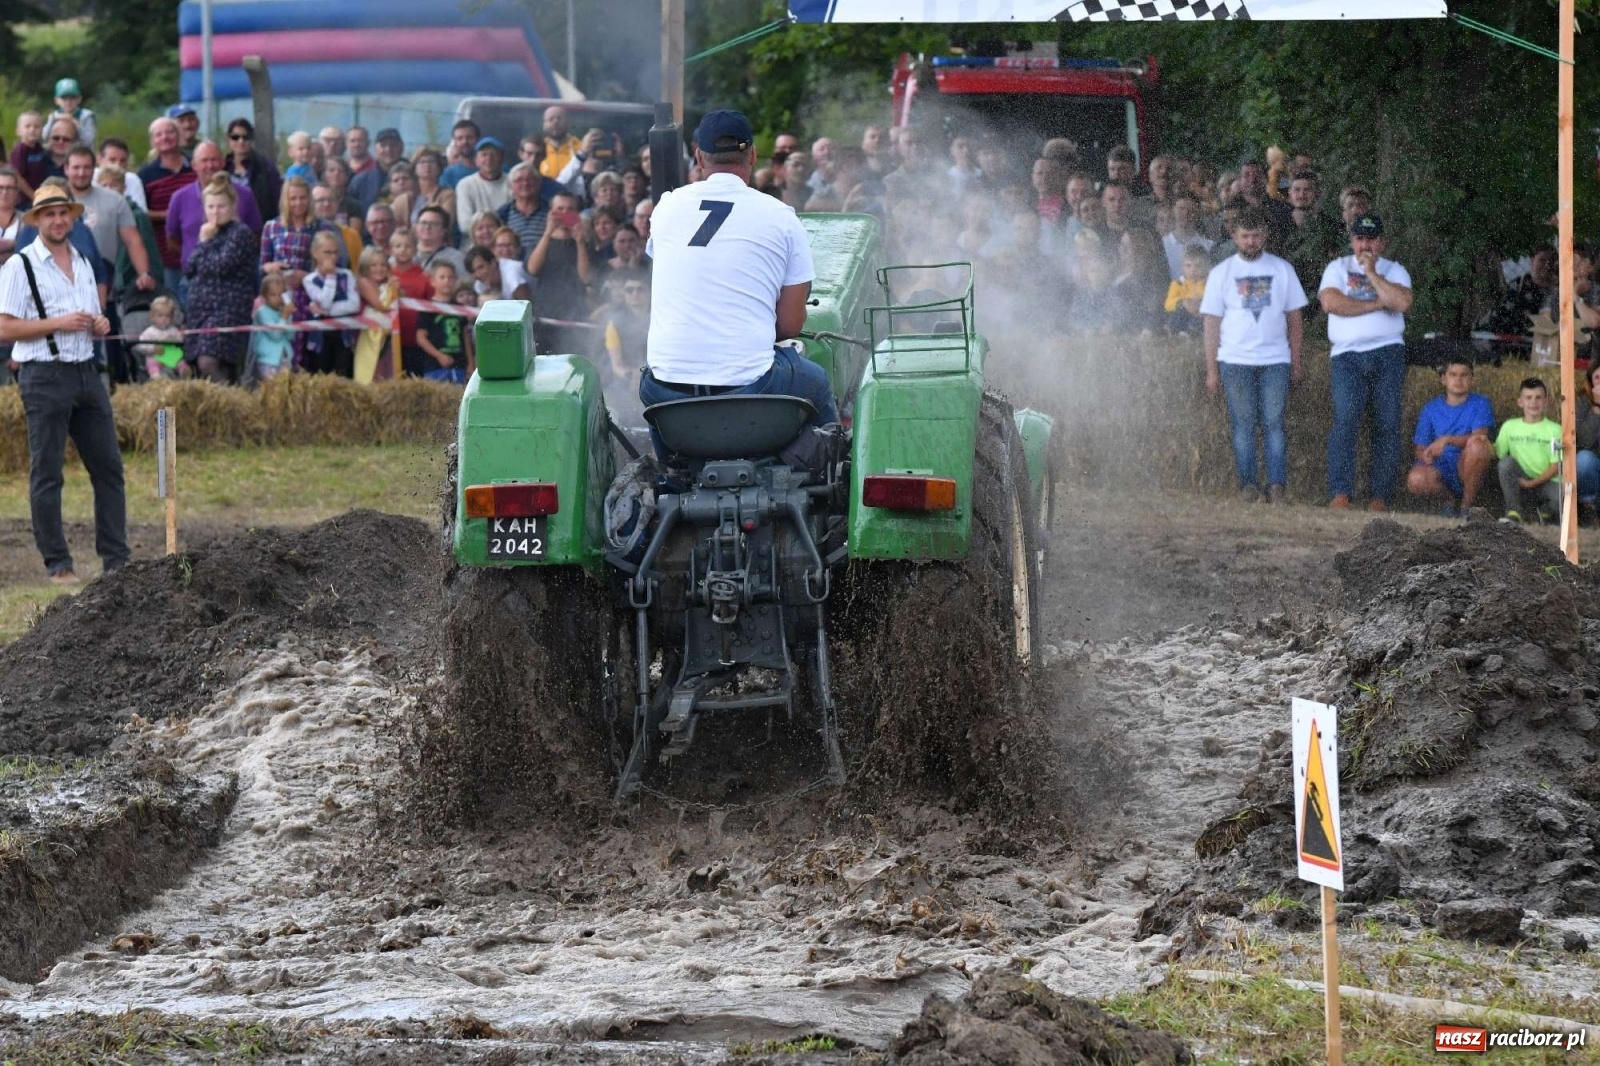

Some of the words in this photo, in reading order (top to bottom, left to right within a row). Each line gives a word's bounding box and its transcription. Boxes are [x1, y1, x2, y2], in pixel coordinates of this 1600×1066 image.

[687, 199, 735, 247] 7
[493, 517, 537, 533] KAH
[490, 538, 542, 554] 2042
